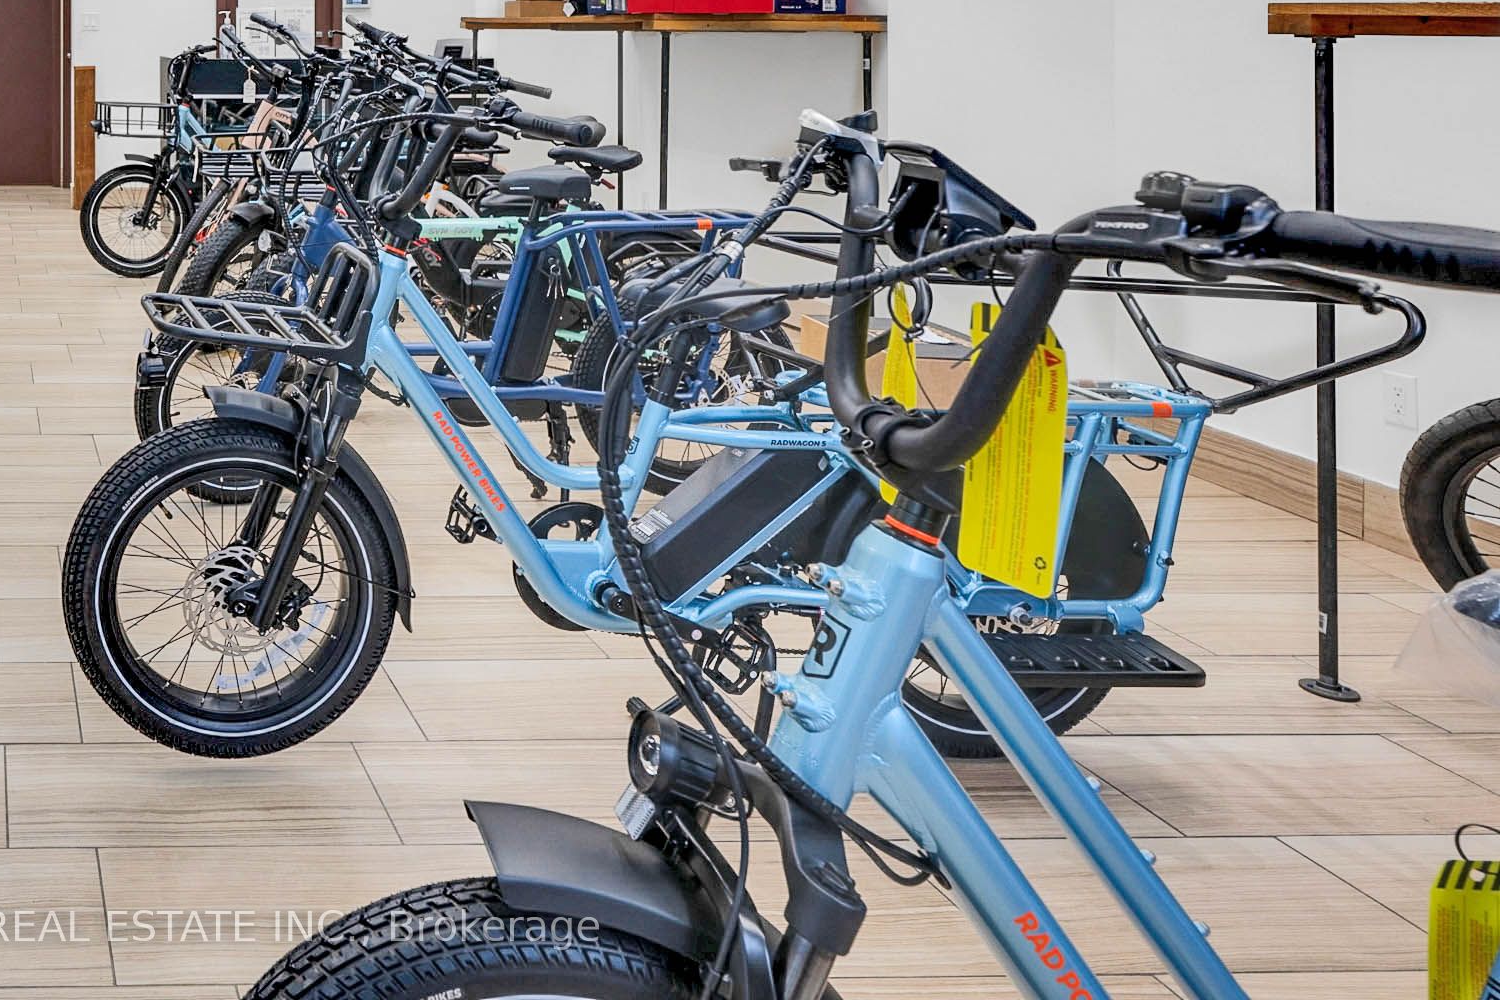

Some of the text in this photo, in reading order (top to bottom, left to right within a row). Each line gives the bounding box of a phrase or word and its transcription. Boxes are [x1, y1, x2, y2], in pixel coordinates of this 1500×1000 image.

[1094, 221, 1149, 230] TEKTRO
[433, 411, 506, 512] RAD POWER BIKES
[1013, 911, 1065, 971] RAD
